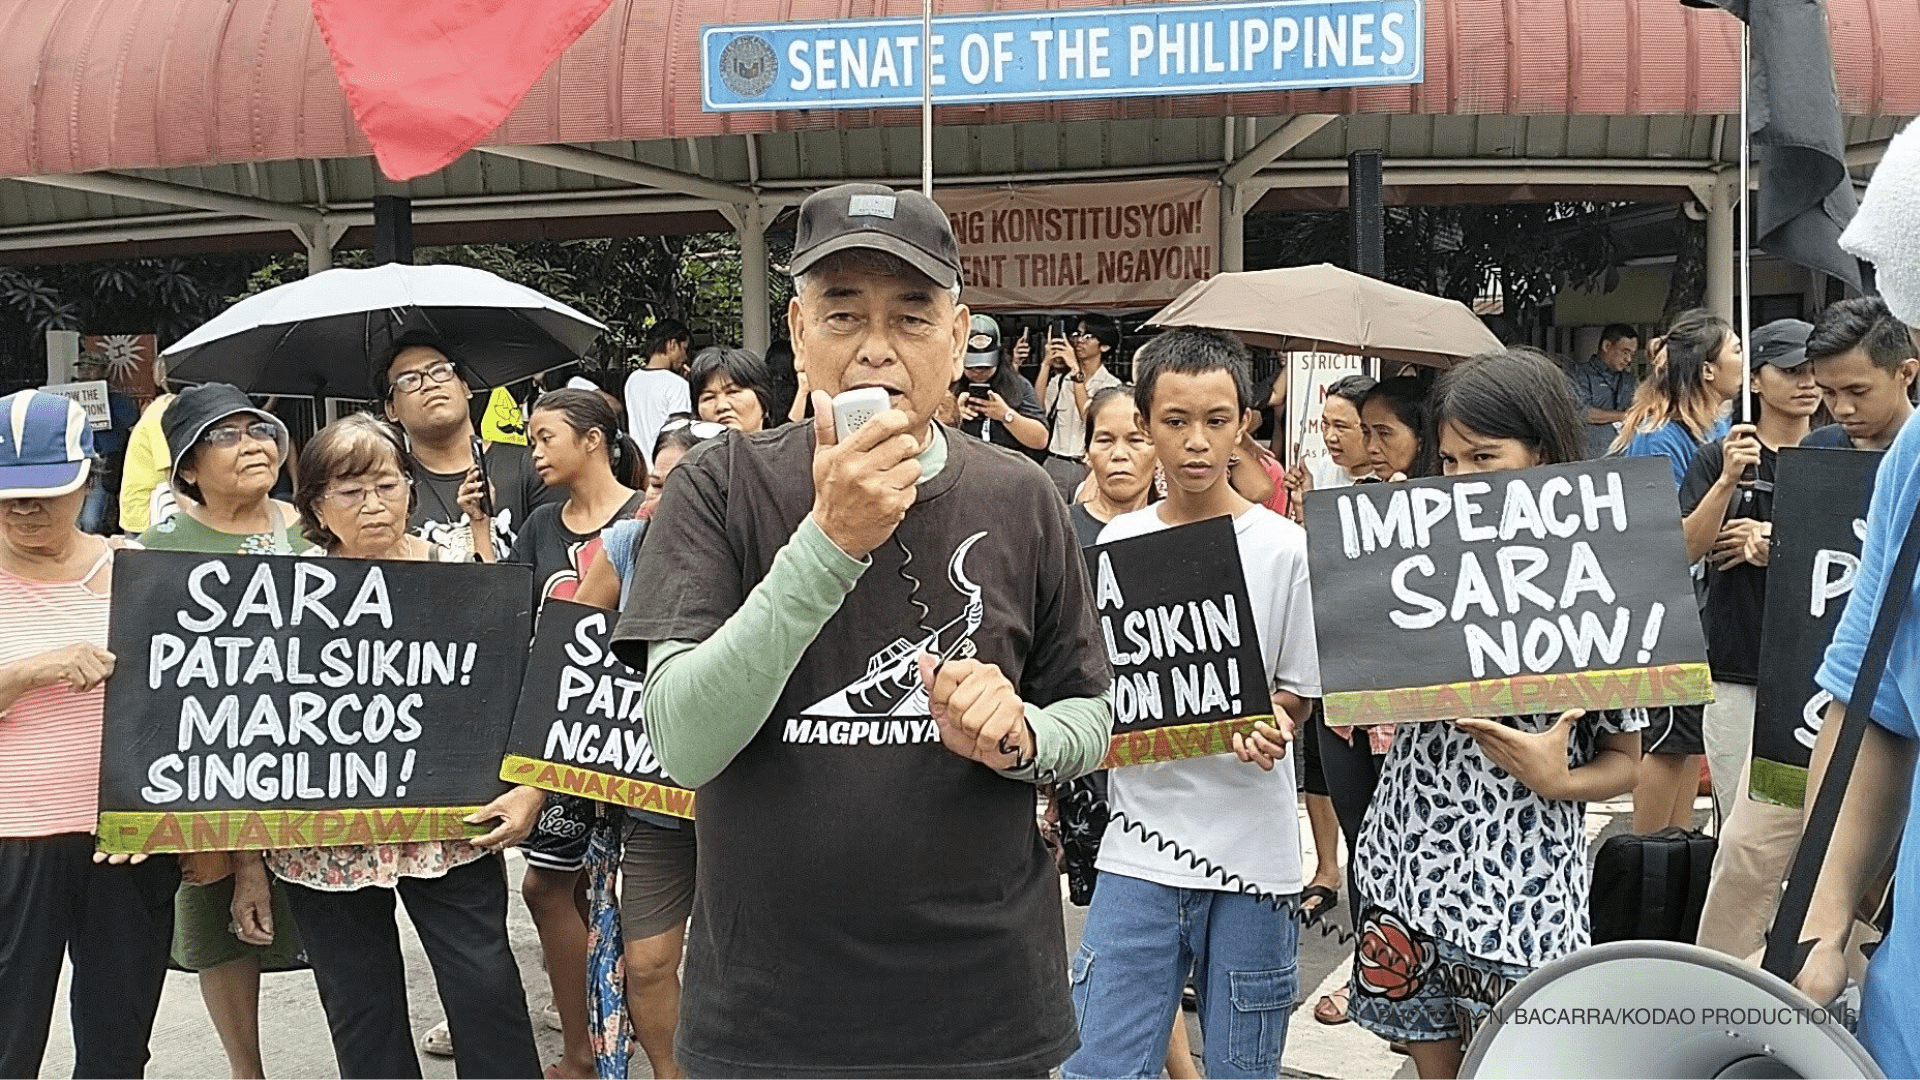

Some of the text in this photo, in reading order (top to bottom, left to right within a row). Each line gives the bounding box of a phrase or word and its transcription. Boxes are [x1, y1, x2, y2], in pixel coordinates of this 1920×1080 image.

[787, 35, 946, 91] SENATE
[960, 31, 1014, 85] OF
[1030, 25, 1110, 80] THE
[1129, 12, 1405, 76] PHILIPPINES
[991, 200, 1202, 245] KONSTITUSYON!
[1014, 251, 1090, 288] TRIAL
[1097, 244, 1211, 284] NGAYON!
[81, 389, 98, 401] THE
[1337, 472, 1627, 559] IMPEACH
[177, 560, 393, 633] SARA
[1389, 541, 1616, 630] SARA
[1101, 594, 1241, 666] LSIKIN
[1463, 602, 1666, 679] NOW!
[149, 633, 477, 690] PATALSIKIN!
[1170, 657, 1242, 720] NA!
[178, 691, 423, 752] MARCOS
[782, 718, 941, 746] MAGPUNYA
[141, 749, 417, 804] SINGILIN!
